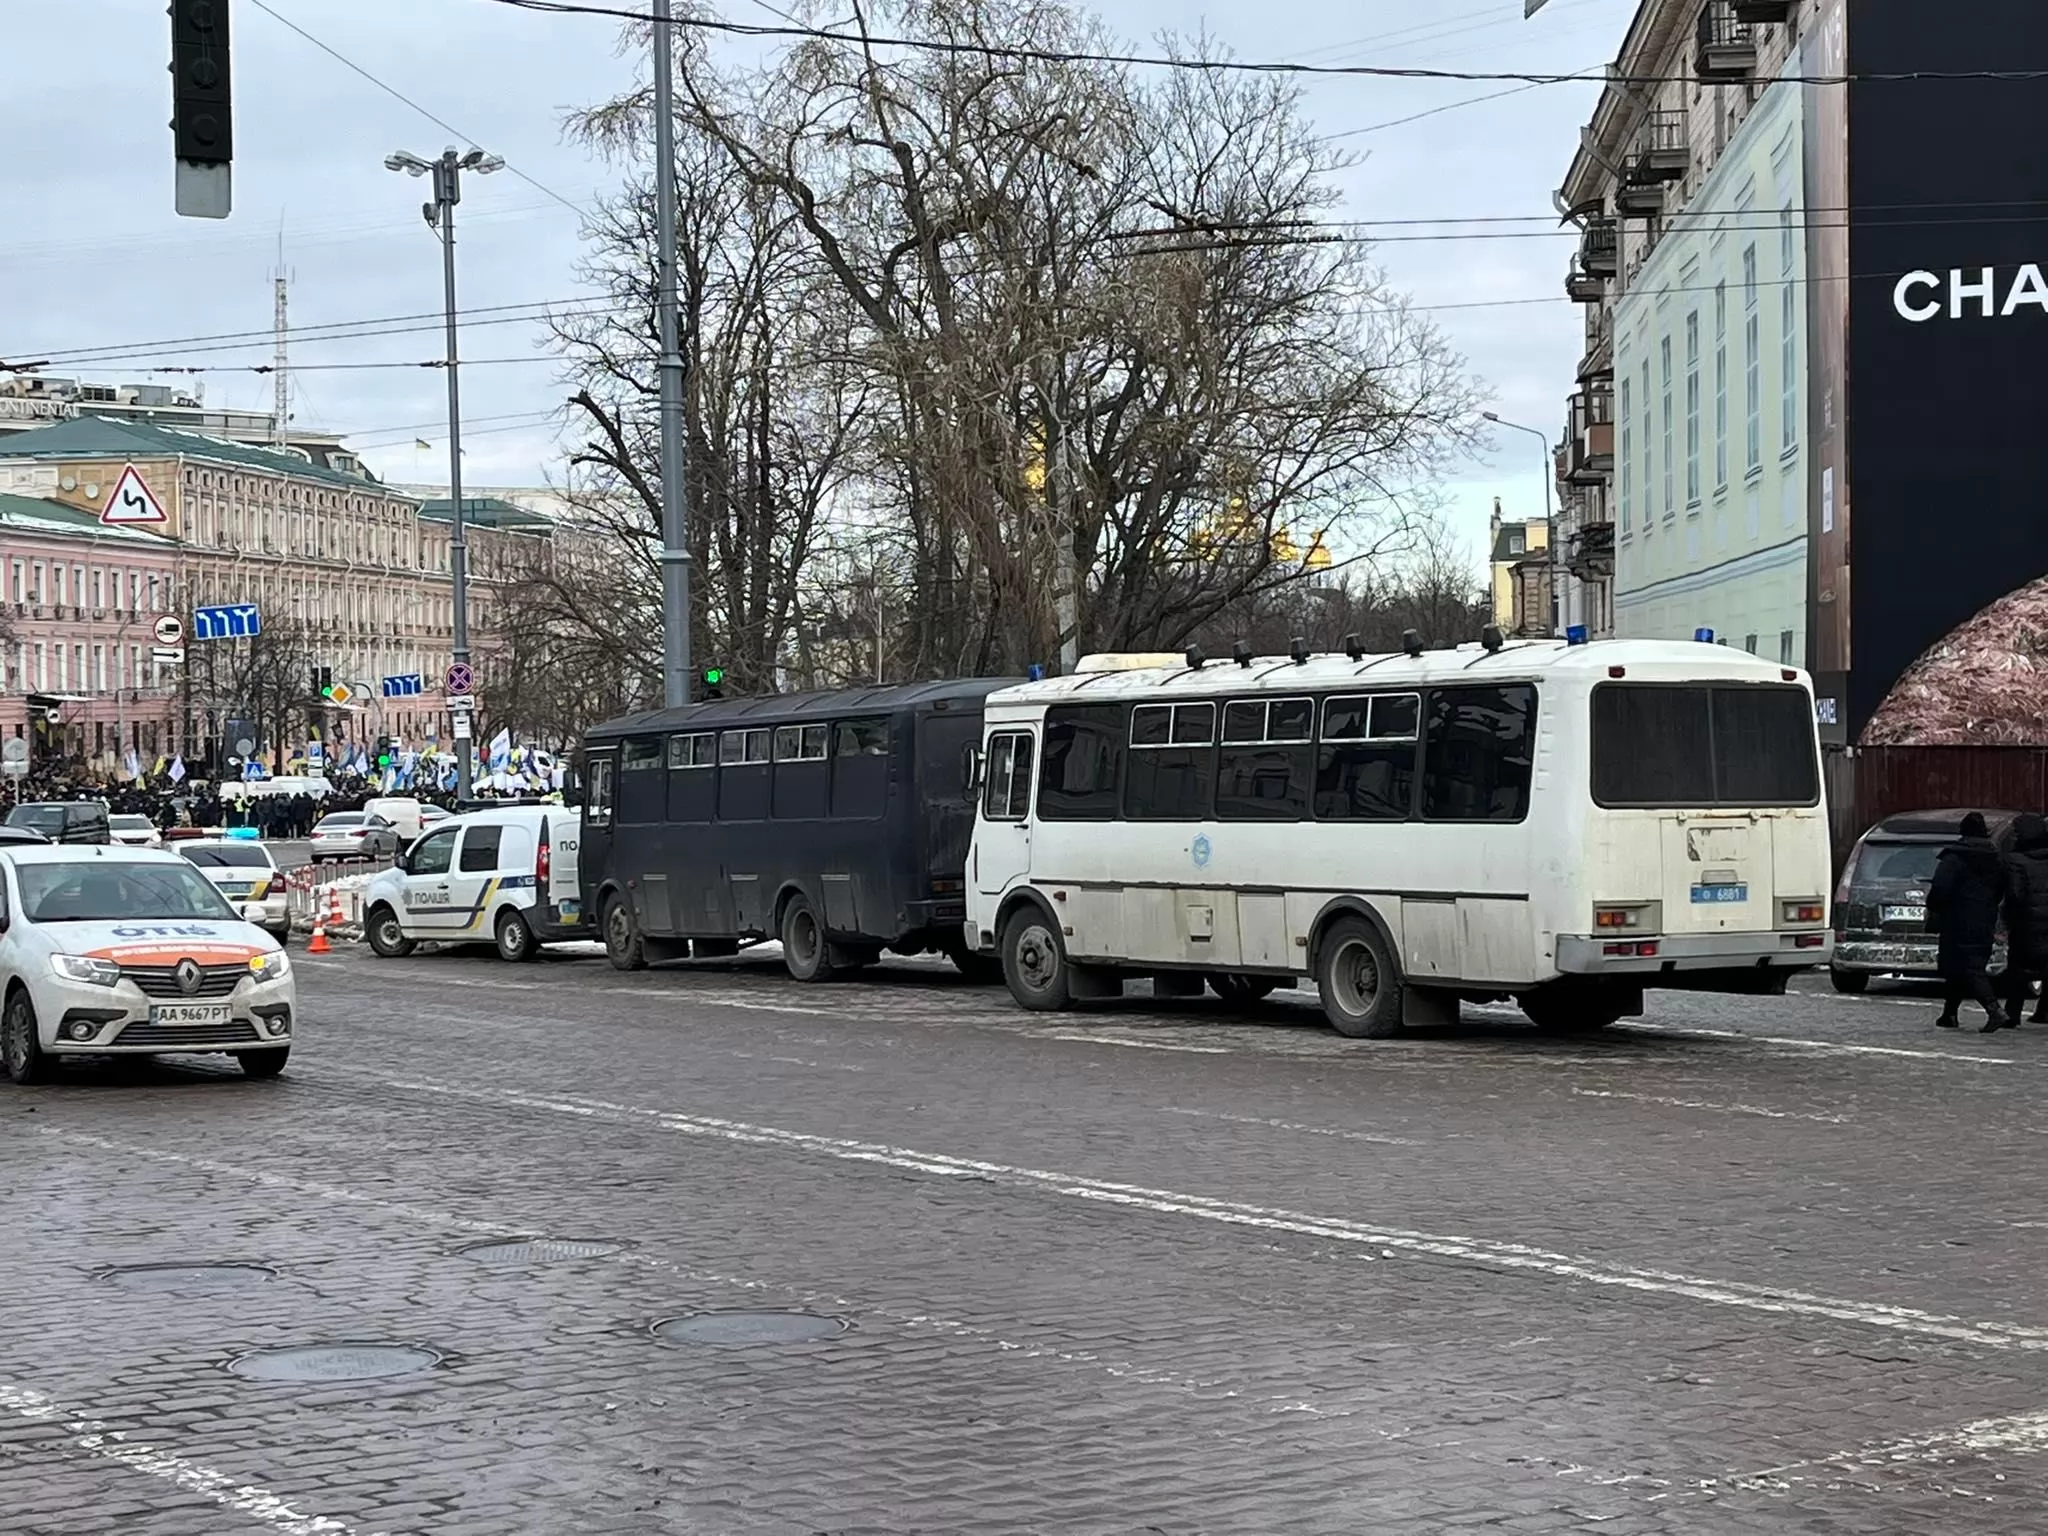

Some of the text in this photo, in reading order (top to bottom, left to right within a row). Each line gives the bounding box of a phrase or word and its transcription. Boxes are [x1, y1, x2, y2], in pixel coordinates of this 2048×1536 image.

[1893, 263, 2048, 322] CHA
[160, 1007, 230, 1021] AA 9667 PT
